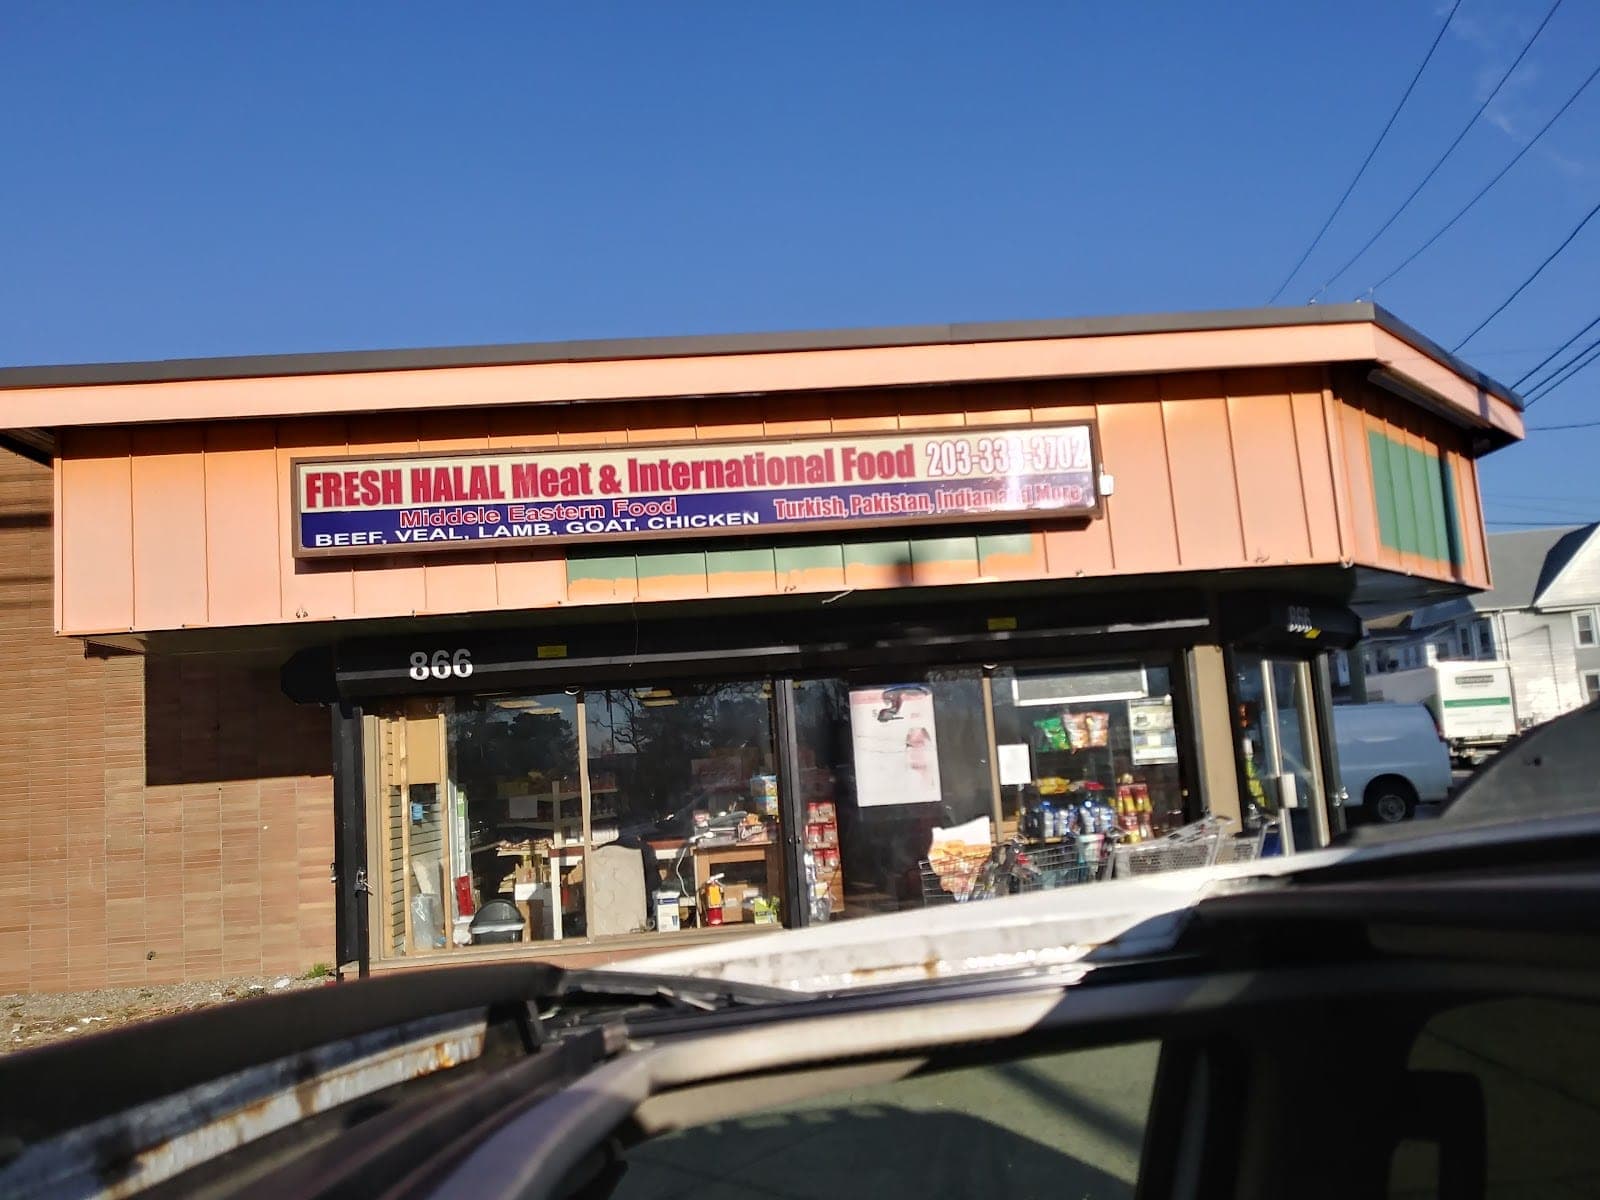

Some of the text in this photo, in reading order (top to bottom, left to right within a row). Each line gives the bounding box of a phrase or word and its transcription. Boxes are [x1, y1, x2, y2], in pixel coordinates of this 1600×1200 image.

[306, 443, 916, 508] FRESH HALAL Meat & International Food
[399, 497, 678, 529] Middele Eastern Food
[774, 496, 849, 520] Turkish,
[850, 491, 934, 516] Pakistan,
[936, 486, 994, 509] Indian
[315, 511, 761, 547] BEEF, VEAL, LAMB, GOAT, CHICKEN
[409, 648, 474, 681] 866
